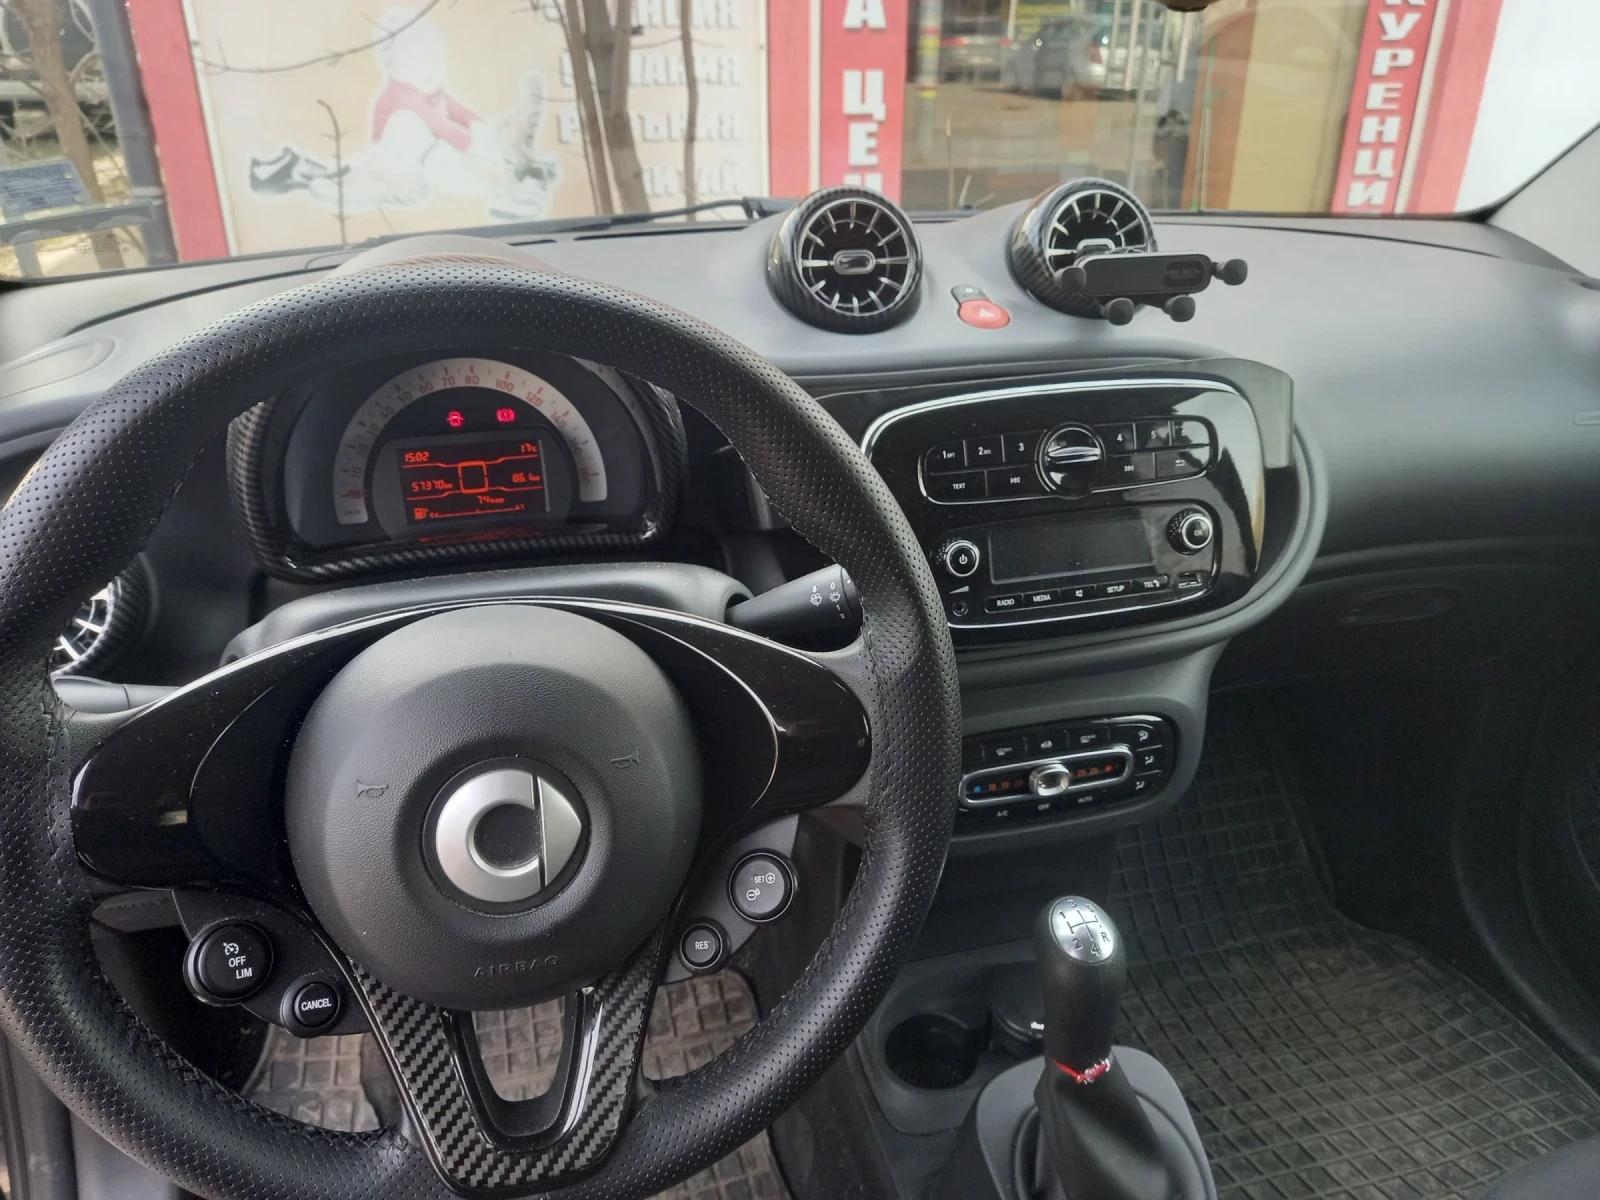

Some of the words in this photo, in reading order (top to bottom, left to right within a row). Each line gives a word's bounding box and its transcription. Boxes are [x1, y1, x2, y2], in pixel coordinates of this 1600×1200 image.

[442, 376, 456, 386] 70
[465, 375, 480, 385] 80
[419, 381, 434, 393] 60
[496, 379, 514, 392] 100
[526, 391, 543, 407] 120
[1117, 433, 1123, 442] 4
[1150, 430, 1157, 439] 5
[1018, 442, 1025, 452] 3
[952, 482, 966, 490] TEXT
[1106, 584, 1125, 594] SETUP
[1143, 580, 1155, 589] TEL
[996, 598, 1015, 607] RADIO
[1033, 594, 1052, 603] MEDIA
[1077, 795, 1093, 804] AUTO
[1037, 803, 1051, 811] OFF
[754, 875, 765, 884] SET
[1059, 911, 1066, 919] 1
[1100, 931, 1110, 942] R
[694, 940, 709, 950] RES
[1072, 938, 1083, 951] 2
[1090, 943, 1100, 957] 4
[228, 955, 246, 968] OFF
[474, 954, 558, 978] AIRBAG
[235, 967, 253, 980] LIM
[300, 997, 332, 1011] CANCEL
